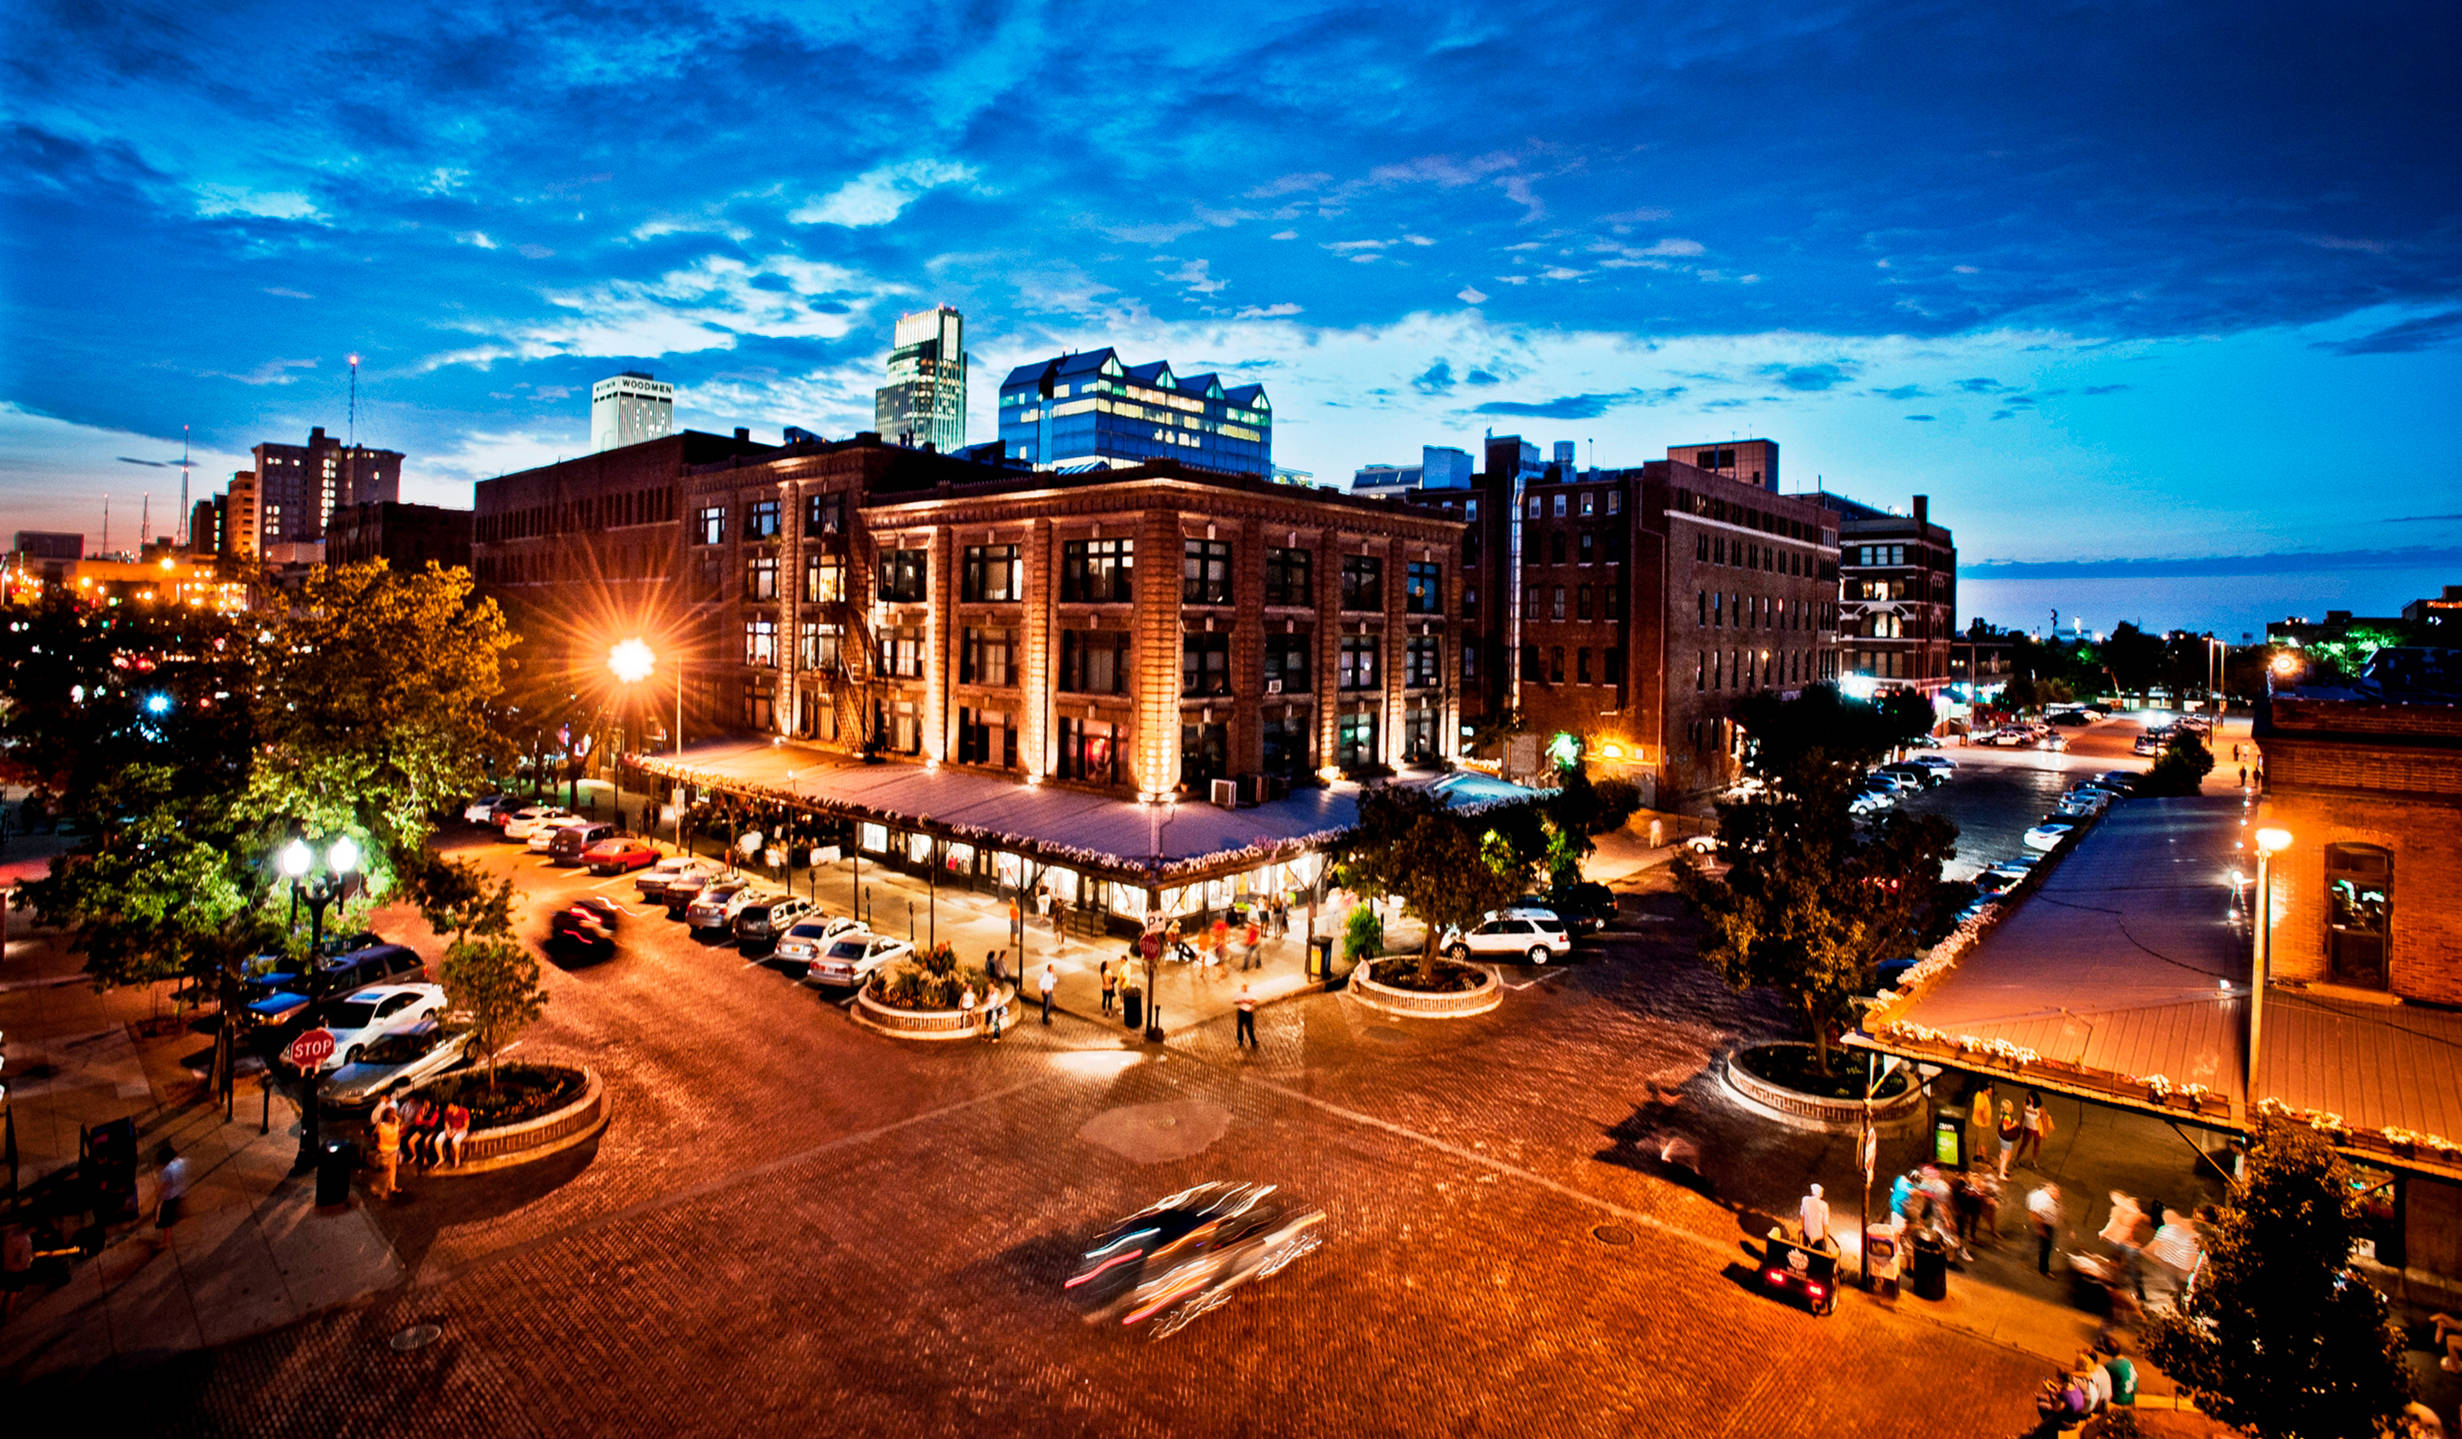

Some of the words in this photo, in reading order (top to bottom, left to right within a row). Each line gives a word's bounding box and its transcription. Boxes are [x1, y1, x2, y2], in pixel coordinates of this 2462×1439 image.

[622, 379, 672, 394] WOODMEN
[1141, 940, 1159, 953] STOP
[294, 1039, 332, 1059] STOP
